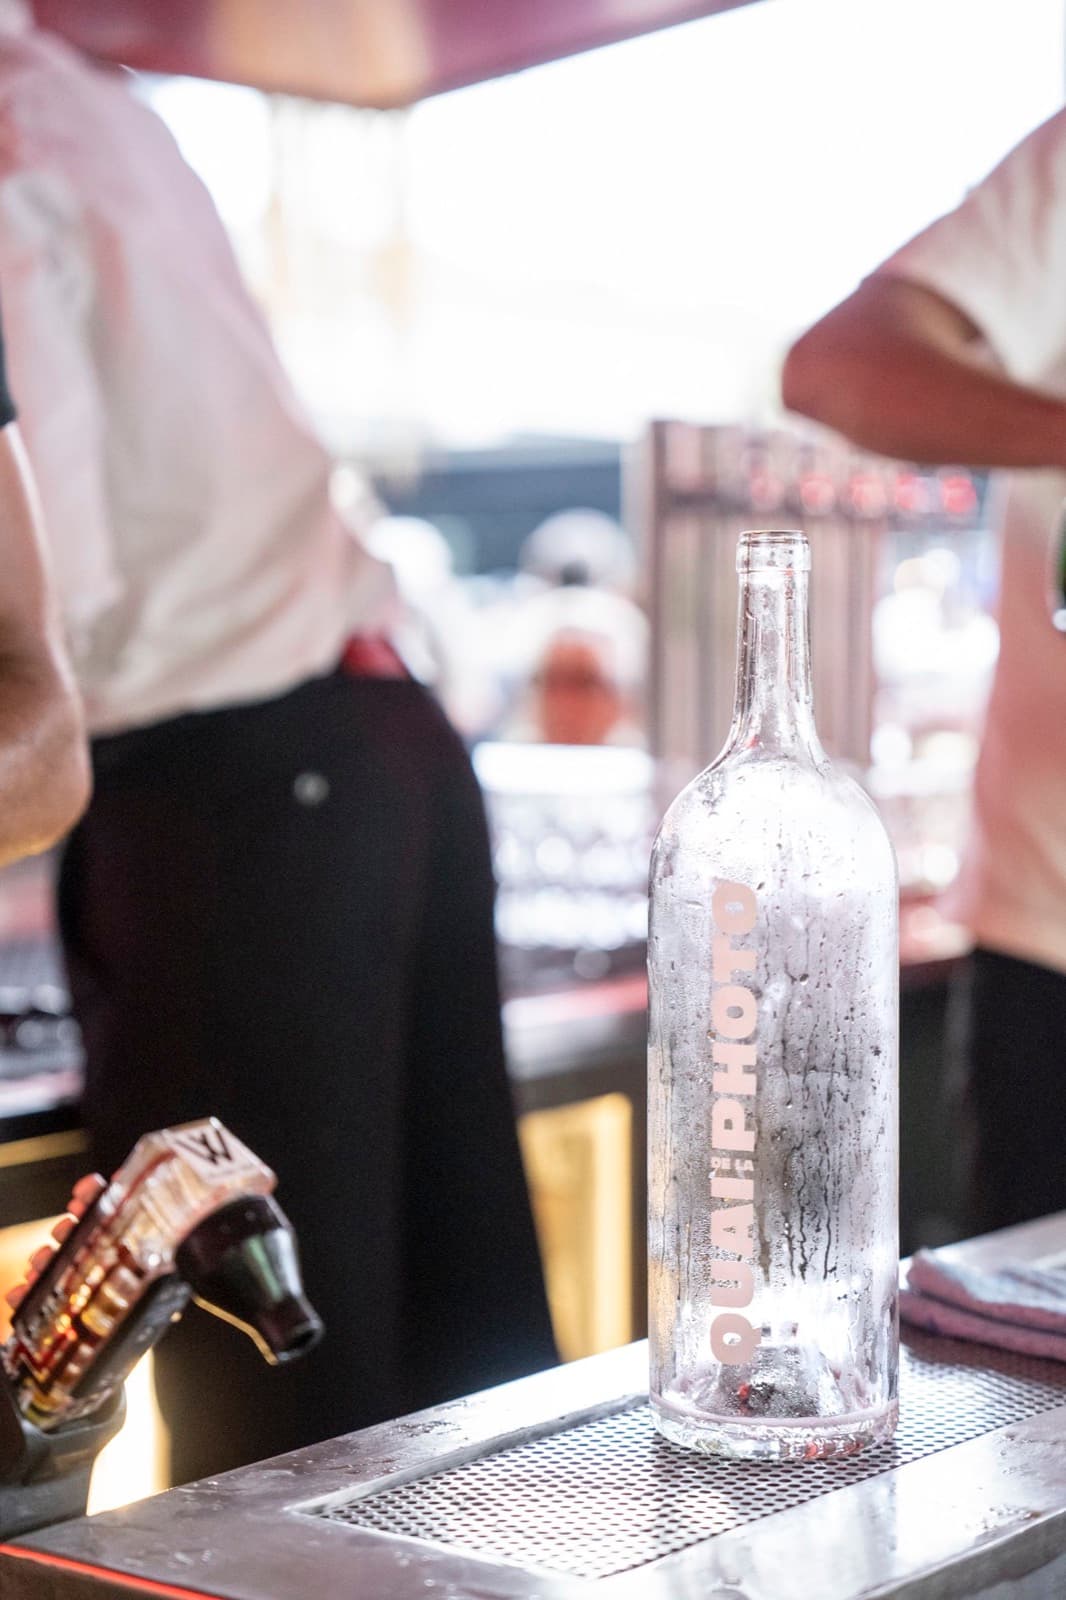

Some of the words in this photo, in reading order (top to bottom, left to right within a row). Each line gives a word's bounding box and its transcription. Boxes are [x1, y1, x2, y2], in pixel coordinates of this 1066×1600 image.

[711, 881, 757, 1151] PHOTO
[176, 1128, 233, 1165] W
[710, 1177, 761, 1365] QUAI
